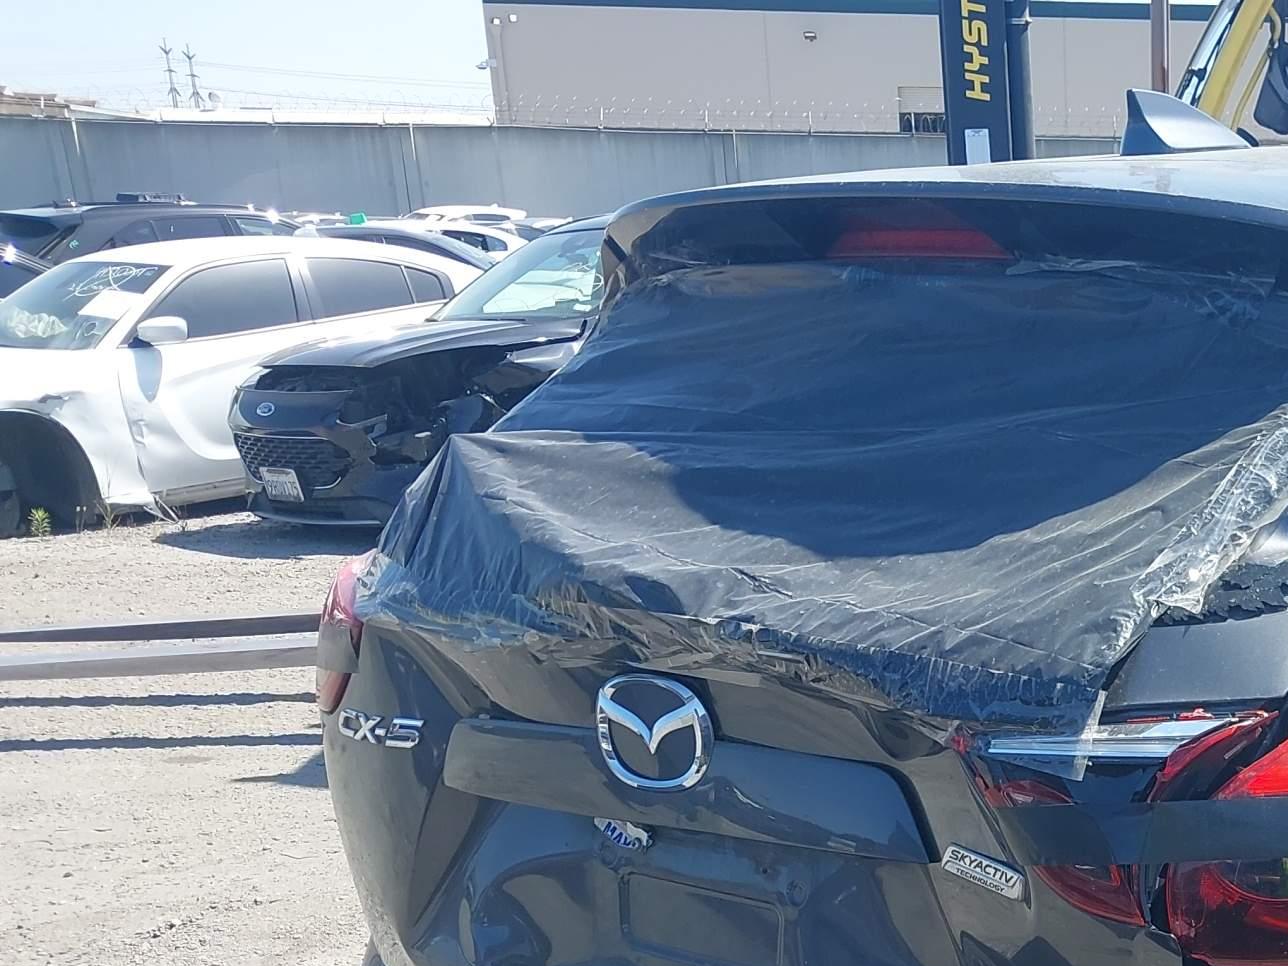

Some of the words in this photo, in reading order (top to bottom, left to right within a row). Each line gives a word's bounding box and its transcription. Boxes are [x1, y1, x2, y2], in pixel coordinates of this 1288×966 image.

[338, 708, 425, 749] CX-5
[949, 849, 1014, 884] SKYACTIV
[955, 867, 1006, 893] TECHNOLOGY
